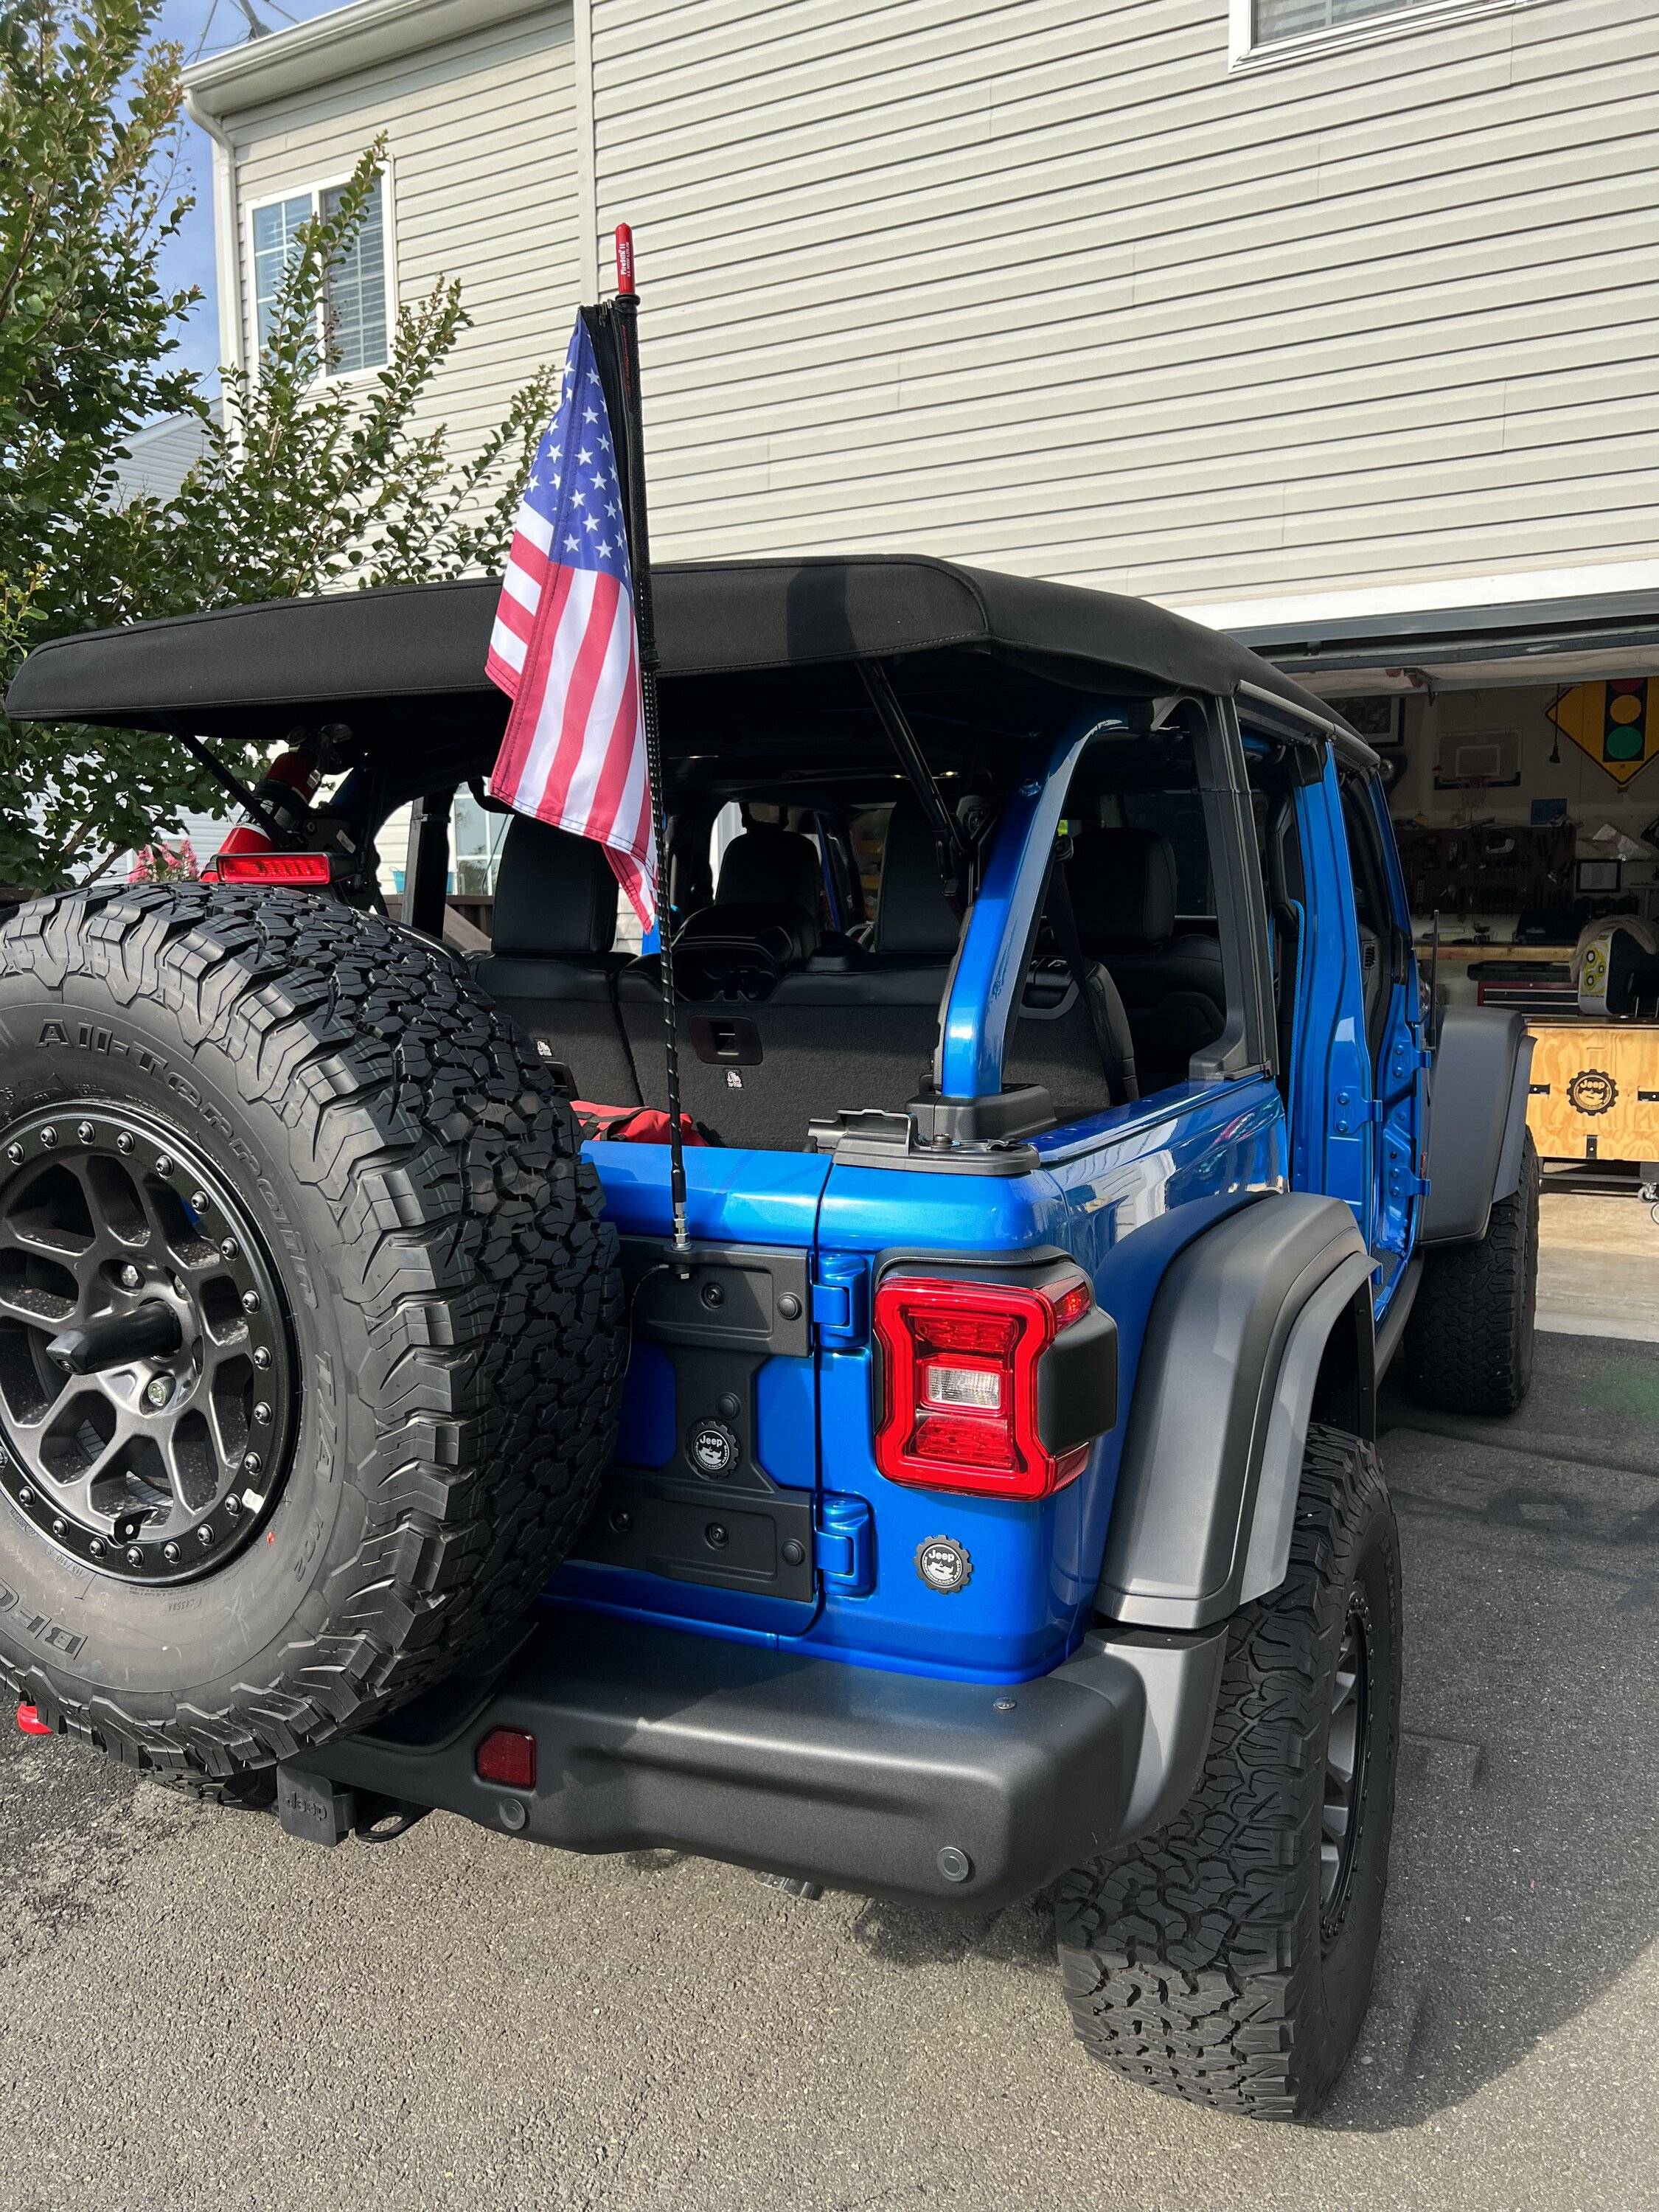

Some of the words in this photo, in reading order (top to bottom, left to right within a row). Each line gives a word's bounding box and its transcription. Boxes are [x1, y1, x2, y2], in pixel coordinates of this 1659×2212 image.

[1579, 1079, 1605, 1090] Jeep
[35, 1018, 319, 1310] All-Terrain
[315, 1351, 338, 1484] T/A
[699, 1435, 723, 1447] Jeep
[928, 1549, 955, 1562] Jeep
[285, 1791, 327, 1822] Jeep
